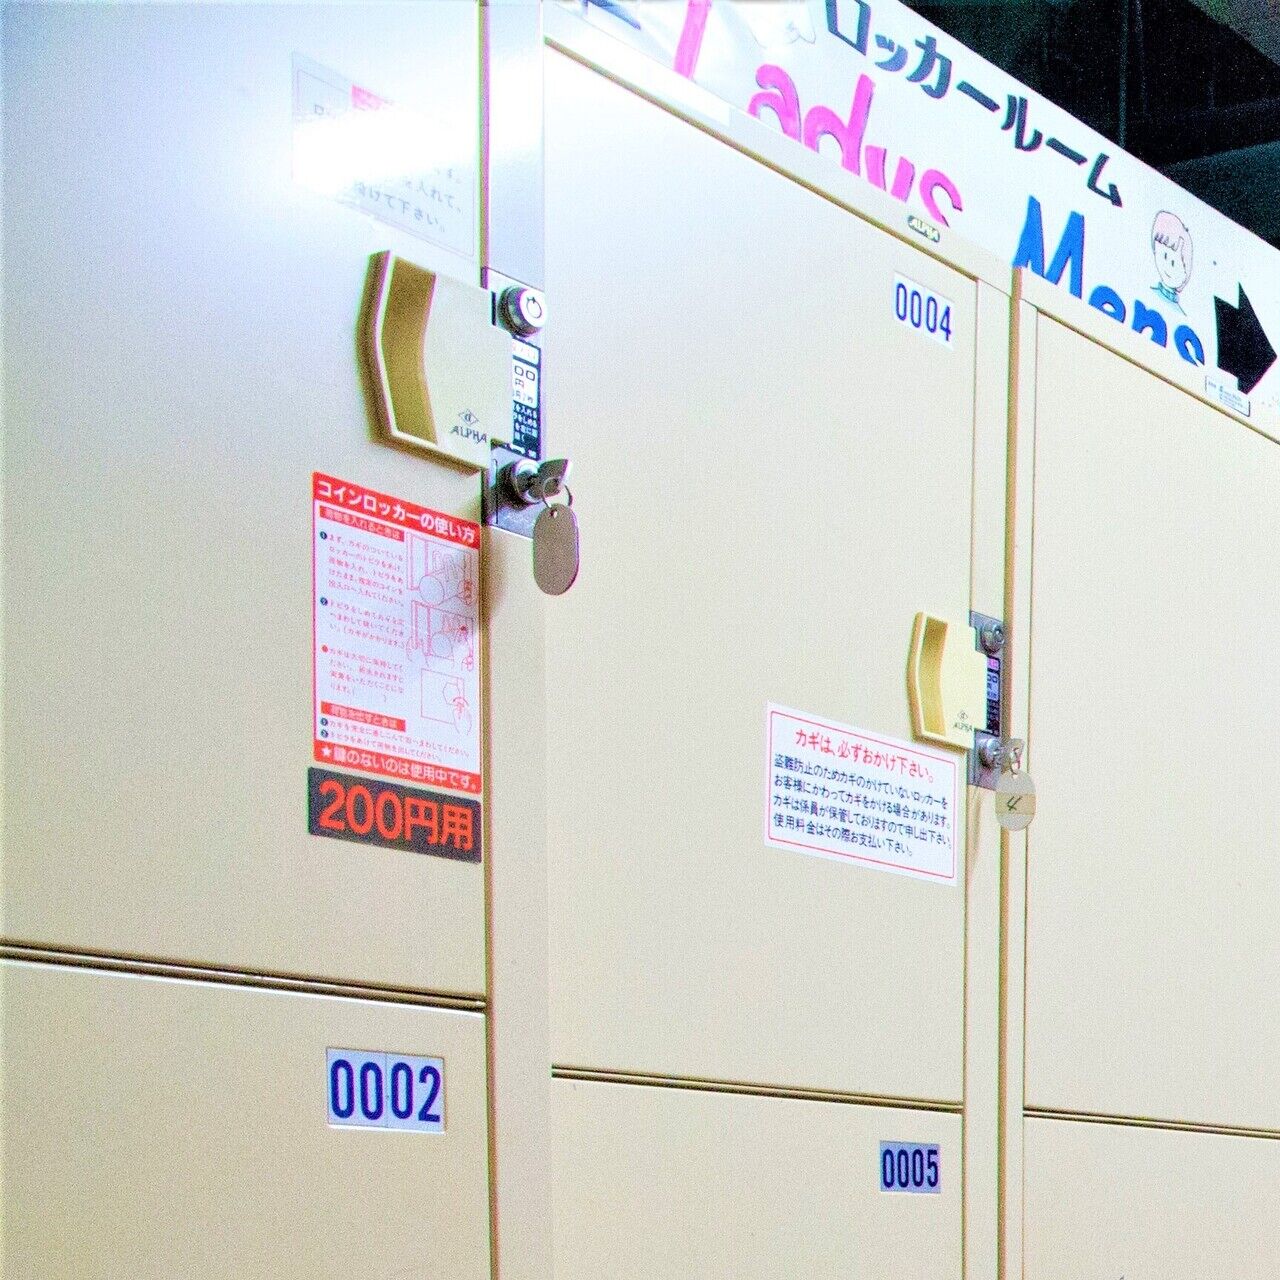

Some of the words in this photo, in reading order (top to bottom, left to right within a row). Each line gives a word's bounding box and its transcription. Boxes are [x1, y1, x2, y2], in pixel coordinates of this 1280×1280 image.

[825, 0, 1122, 207] ロッカールーム
[895, 282, 951, 342] 0004
[451, 425, 488, 444] ALPHA
[318, 480, 475, 544] コインロッカーの使い方
[796, 729, 934, 784] カギは、必ずおかけ下さい。
[318, 778, 474, 852] 200円用
[330, 1059, 441, 1122] 0002
[882, 1149, 939, 1188] 0005
